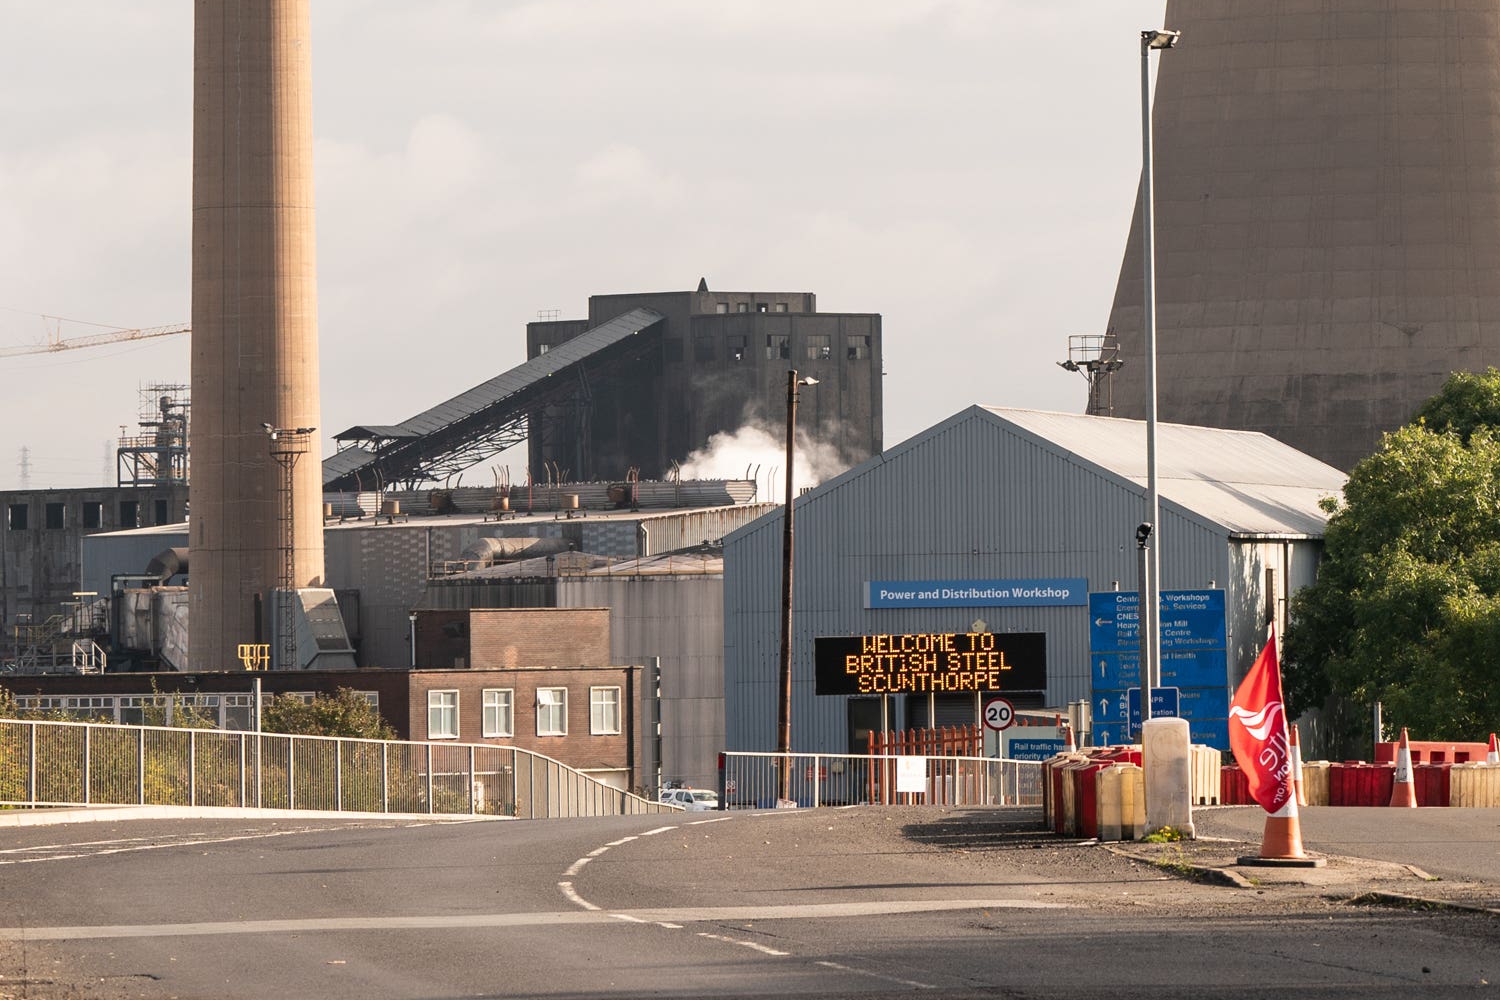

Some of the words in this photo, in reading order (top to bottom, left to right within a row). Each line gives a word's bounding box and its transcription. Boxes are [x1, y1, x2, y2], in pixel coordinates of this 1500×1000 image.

[880, 589, 916, 600] Power
[918, 588, 939, 600] and
[942, 588, 1009, 599] Distribution
[1012, 587, 1070, 600] Workshop
[1166, 594, 1210, 602] Workshops
[863, 634, 956, 653] WELCOME
[966, 632, 994, 650] TO
[846, 654, 937, 674] BRITISH
[948, 652, 1012, 670] STEEL
[858, 672, 1000, 692] SCUNTHORPE
[988, 707, 1010, 720] 20
